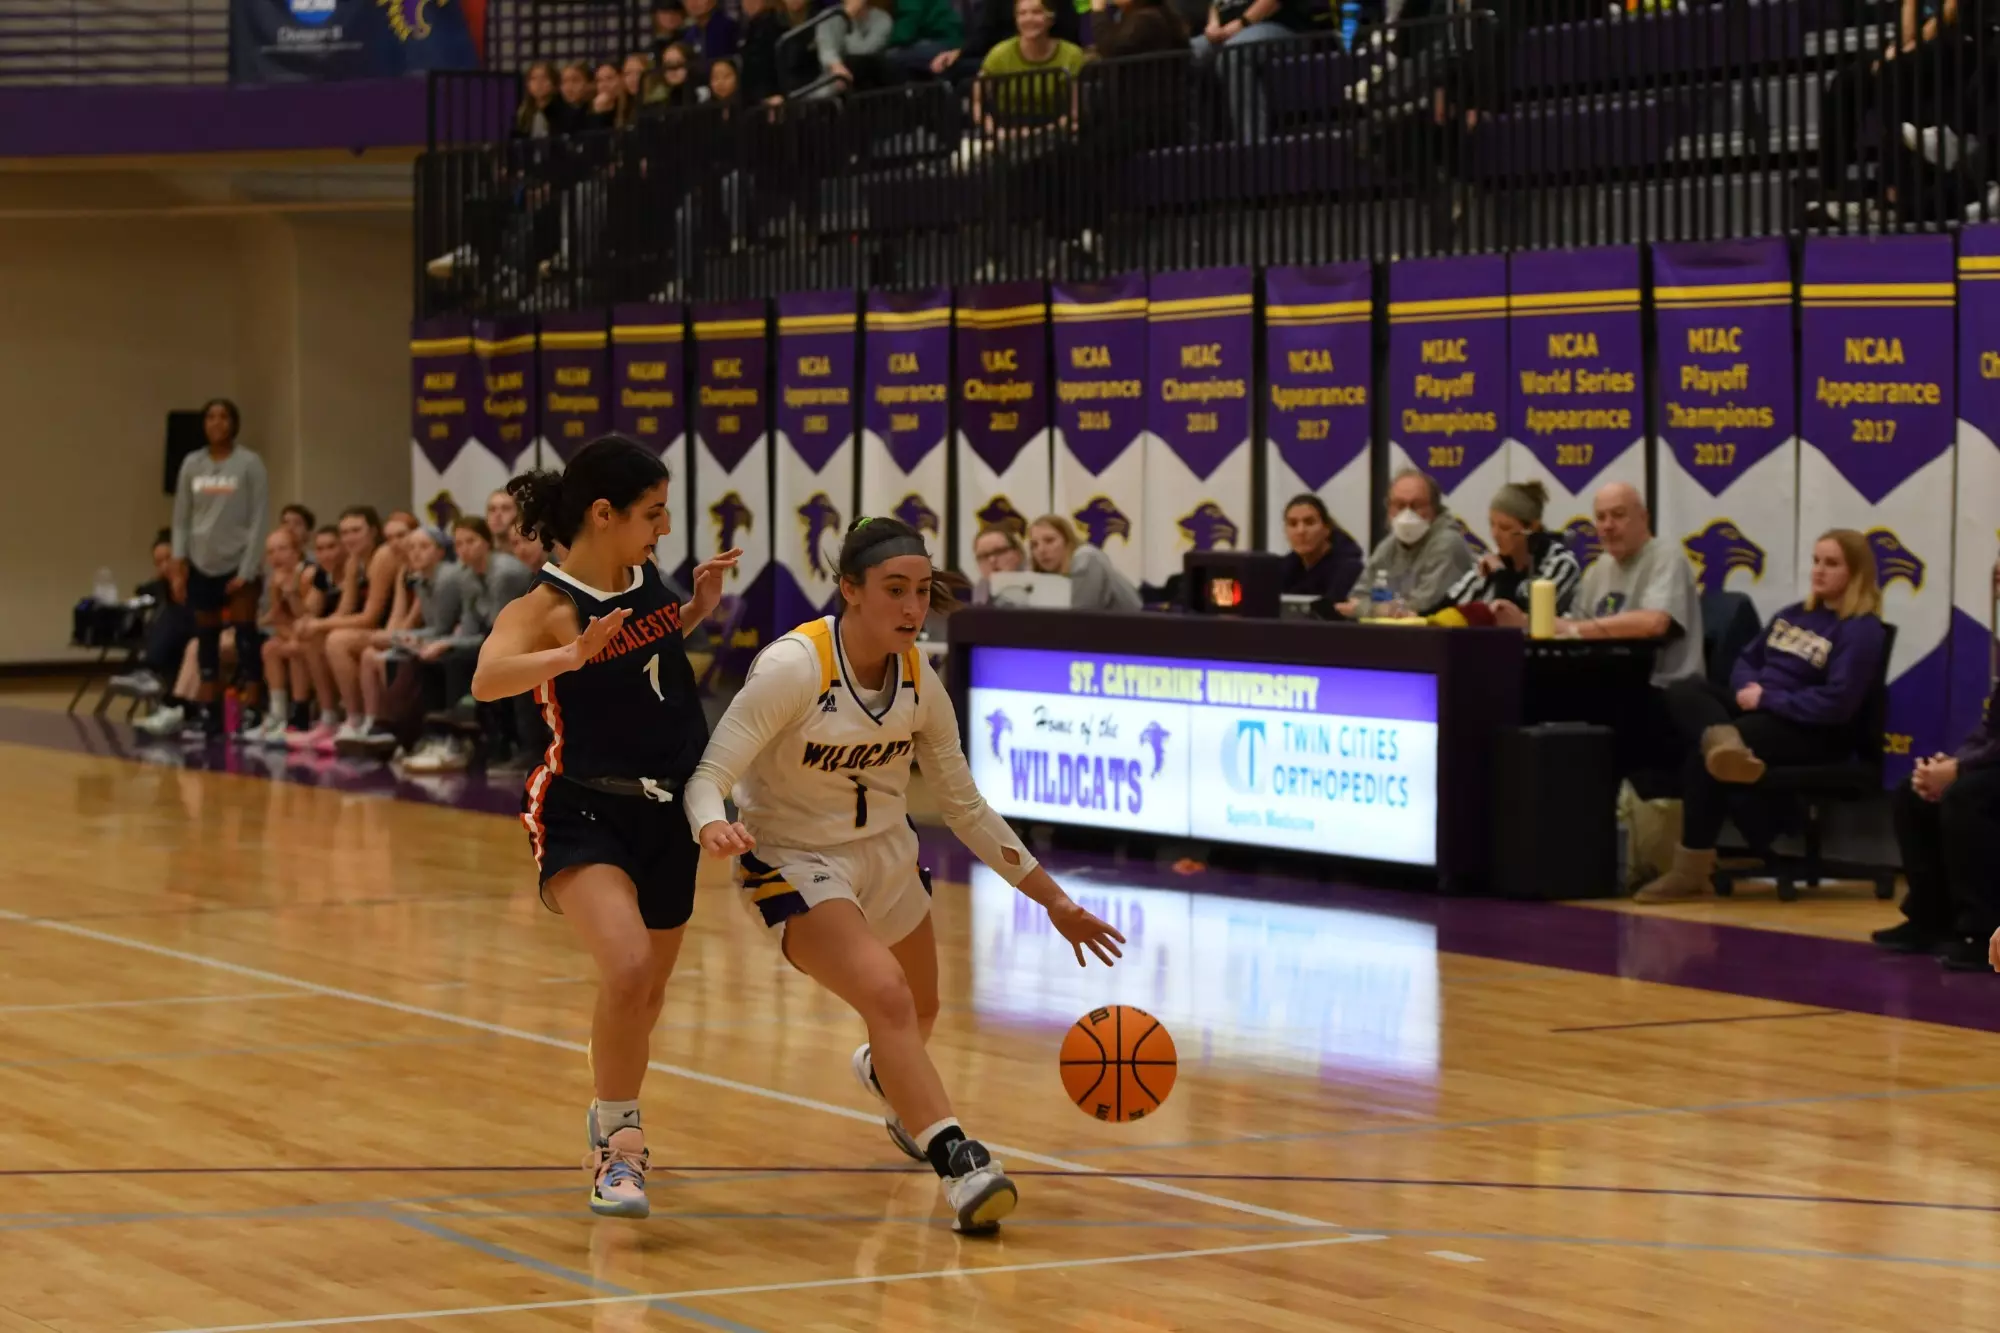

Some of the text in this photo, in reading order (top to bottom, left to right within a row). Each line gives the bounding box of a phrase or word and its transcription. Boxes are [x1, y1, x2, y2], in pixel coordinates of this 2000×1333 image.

[1421, 338, 1468, 363] MIAC
[1548, 332, 1598, 358] NCAA
[1688, 326, 1742, 353] MIAC
[1845, 337, 1904, 364] NCAA
[1071, 346, 1111, 368] NCAA
[1288, 349, 1334, 373] NCAA
[1161, 376, 1246, 404] Champions
[1415, 371, 1475, 403] Playoff
[1520, 367, 1635, 394] World Series
[1681, 363, 1748, 396] Playoff
[1817, 376, 1940, 408] Appearance
[1402, 407, 1497, 437] Champions
[1526, 405, 1631, 435] Appearance
[1852, 419, 1896, 443] 2017
[1428, 446, 1463, 467] 2017
[1556, 443, 1593, 466] 2017
[1694, 443, 1736, 466] 2017
[643, 653, 665, 702] 1
[1070, 661, 1319, 710] ST. CATHERINE UNIVERSITY
[1033, 704, 1073, 735] Home
[1098, 711, 1118, 739] the
[802, 740, 912, 772] WILDCAT
[1283, 721, 1398, 762] TWIN CITIES
[1010, 748, 1142, 814] WILDCATS
[1273, 765, 1409, 808] ORTHOPEDICS
